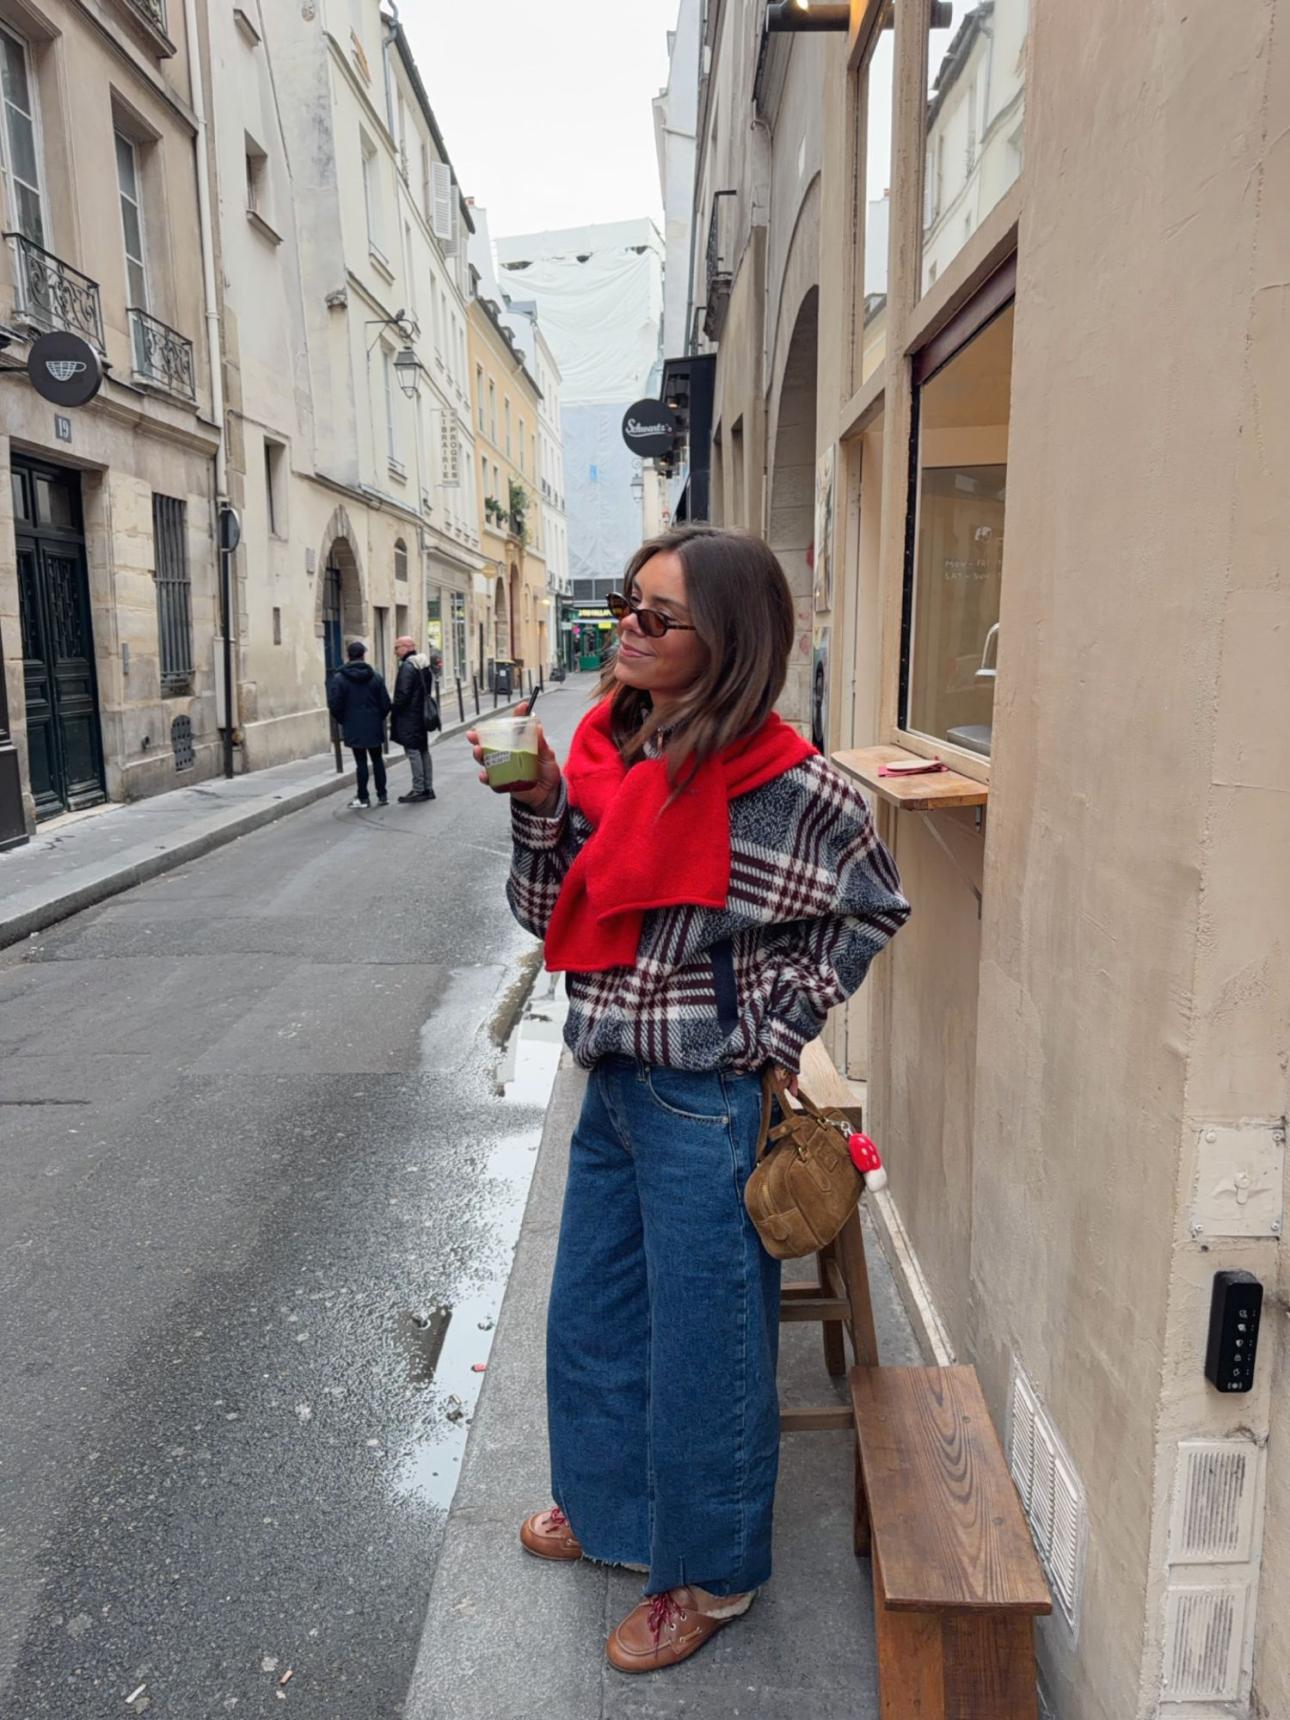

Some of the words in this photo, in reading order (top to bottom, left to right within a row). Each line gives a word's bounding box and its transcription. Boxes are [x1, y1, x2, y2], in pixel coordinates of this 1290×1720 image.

[58, 418, 69, 438] 19
[625, 418, 673, 437] Schwartz's
[440, 410, 449, 479] LIBRAIRIE
